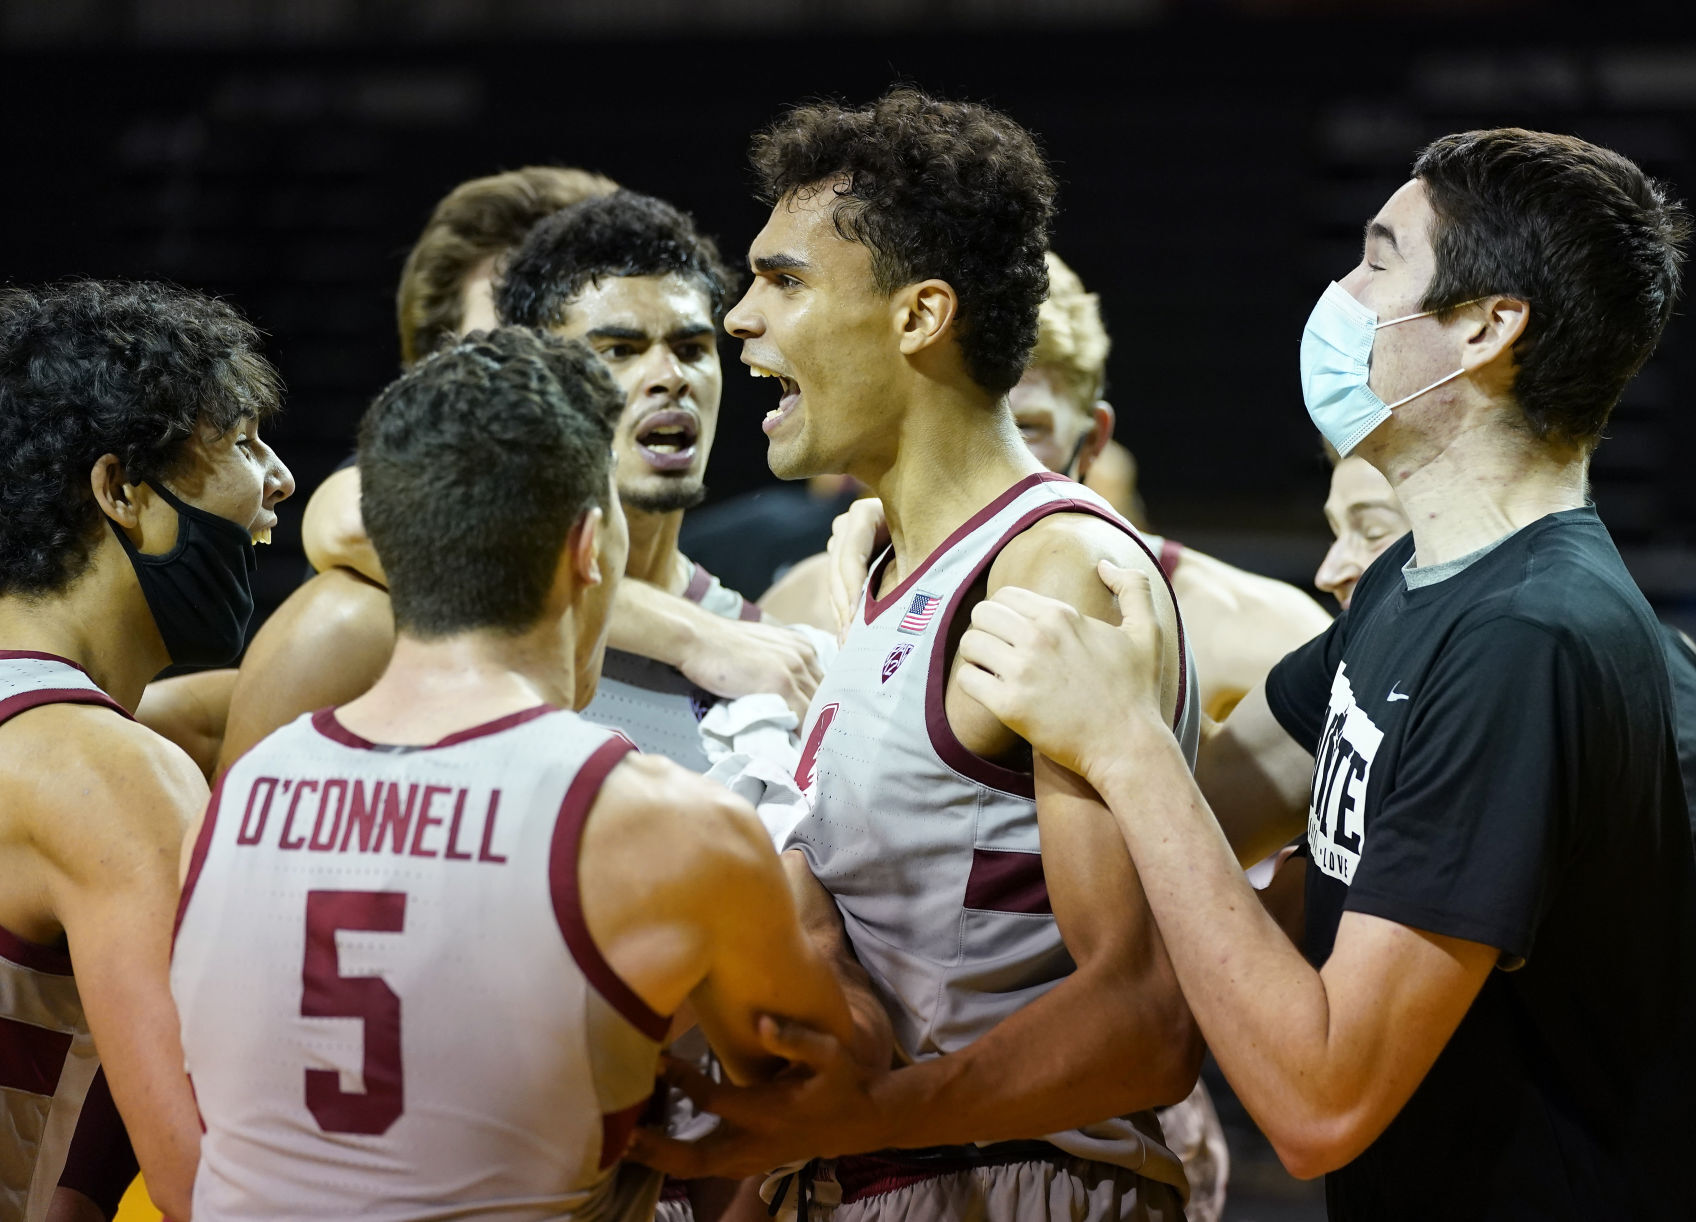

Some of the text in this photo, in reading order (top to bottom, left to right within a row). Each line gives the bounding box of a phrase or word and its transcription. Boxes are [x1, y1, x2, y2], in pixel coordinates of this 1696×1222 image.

[236, 776, 507, 863] O'CONNELL
[1322, 847, 1348, 879] LOVE
[300, 890, 407, 1135] 5
